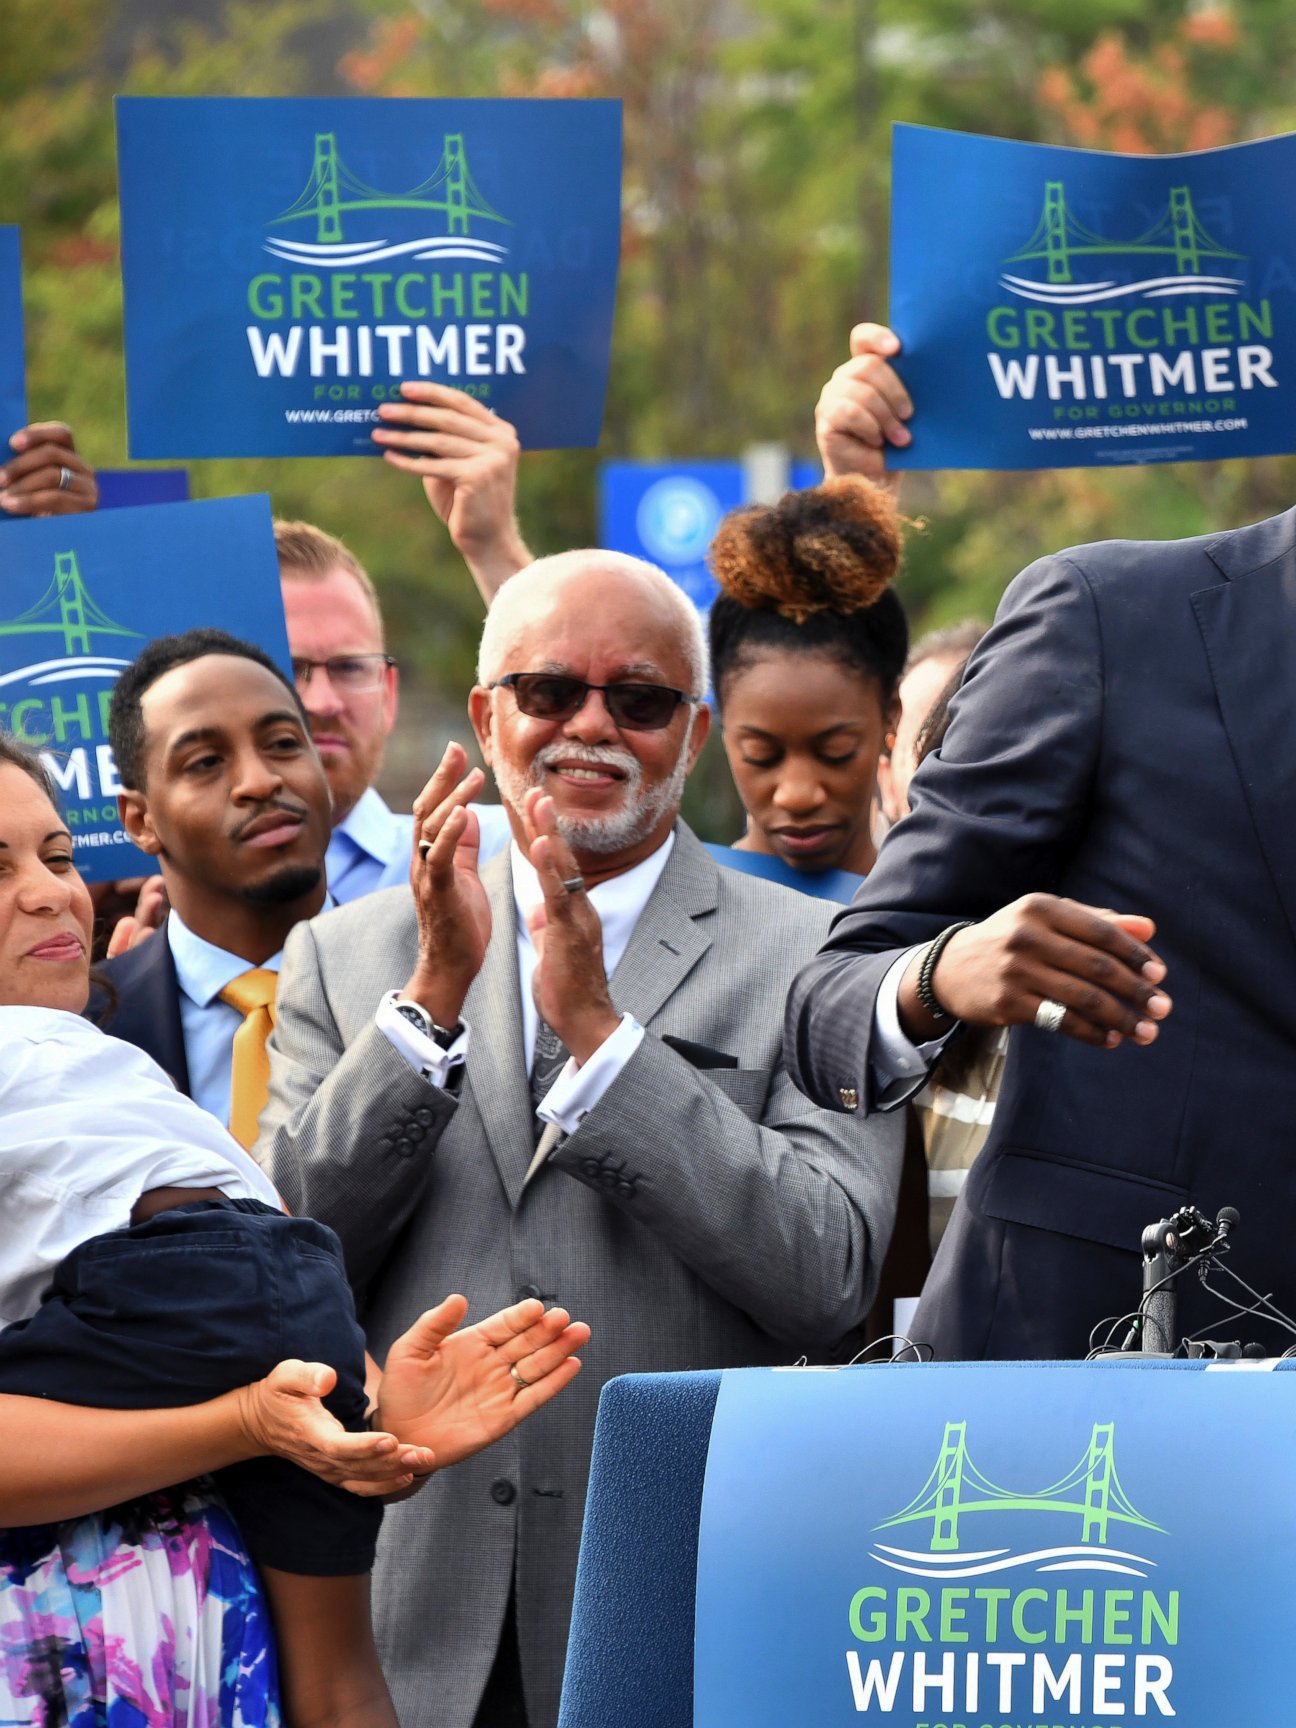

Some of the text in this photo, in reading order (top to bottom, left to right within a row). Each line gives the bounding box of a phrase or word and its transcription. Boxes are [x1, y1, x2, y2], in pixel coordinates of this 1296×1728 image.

[247, 273, 530, 319] GRETCHEN
[987, 299, 1273, 350] GRETCHEN
[246, 324, 527, 378] WHITMER
[987, 345, 1279, 400] WHITMER
[313, 382, 491, 401] FOR GOOR
[1053, 398, 1237, 421] FOR GOVERNOR
[1028, 417, 1248, 441] WWW.GRETCHENWHITMER.COM
[0, 690, 113, 746] CH
[848, 1586, 1180, 1645] GRETCHEN
[845, 1651, 1176, 1716] WHITMER
